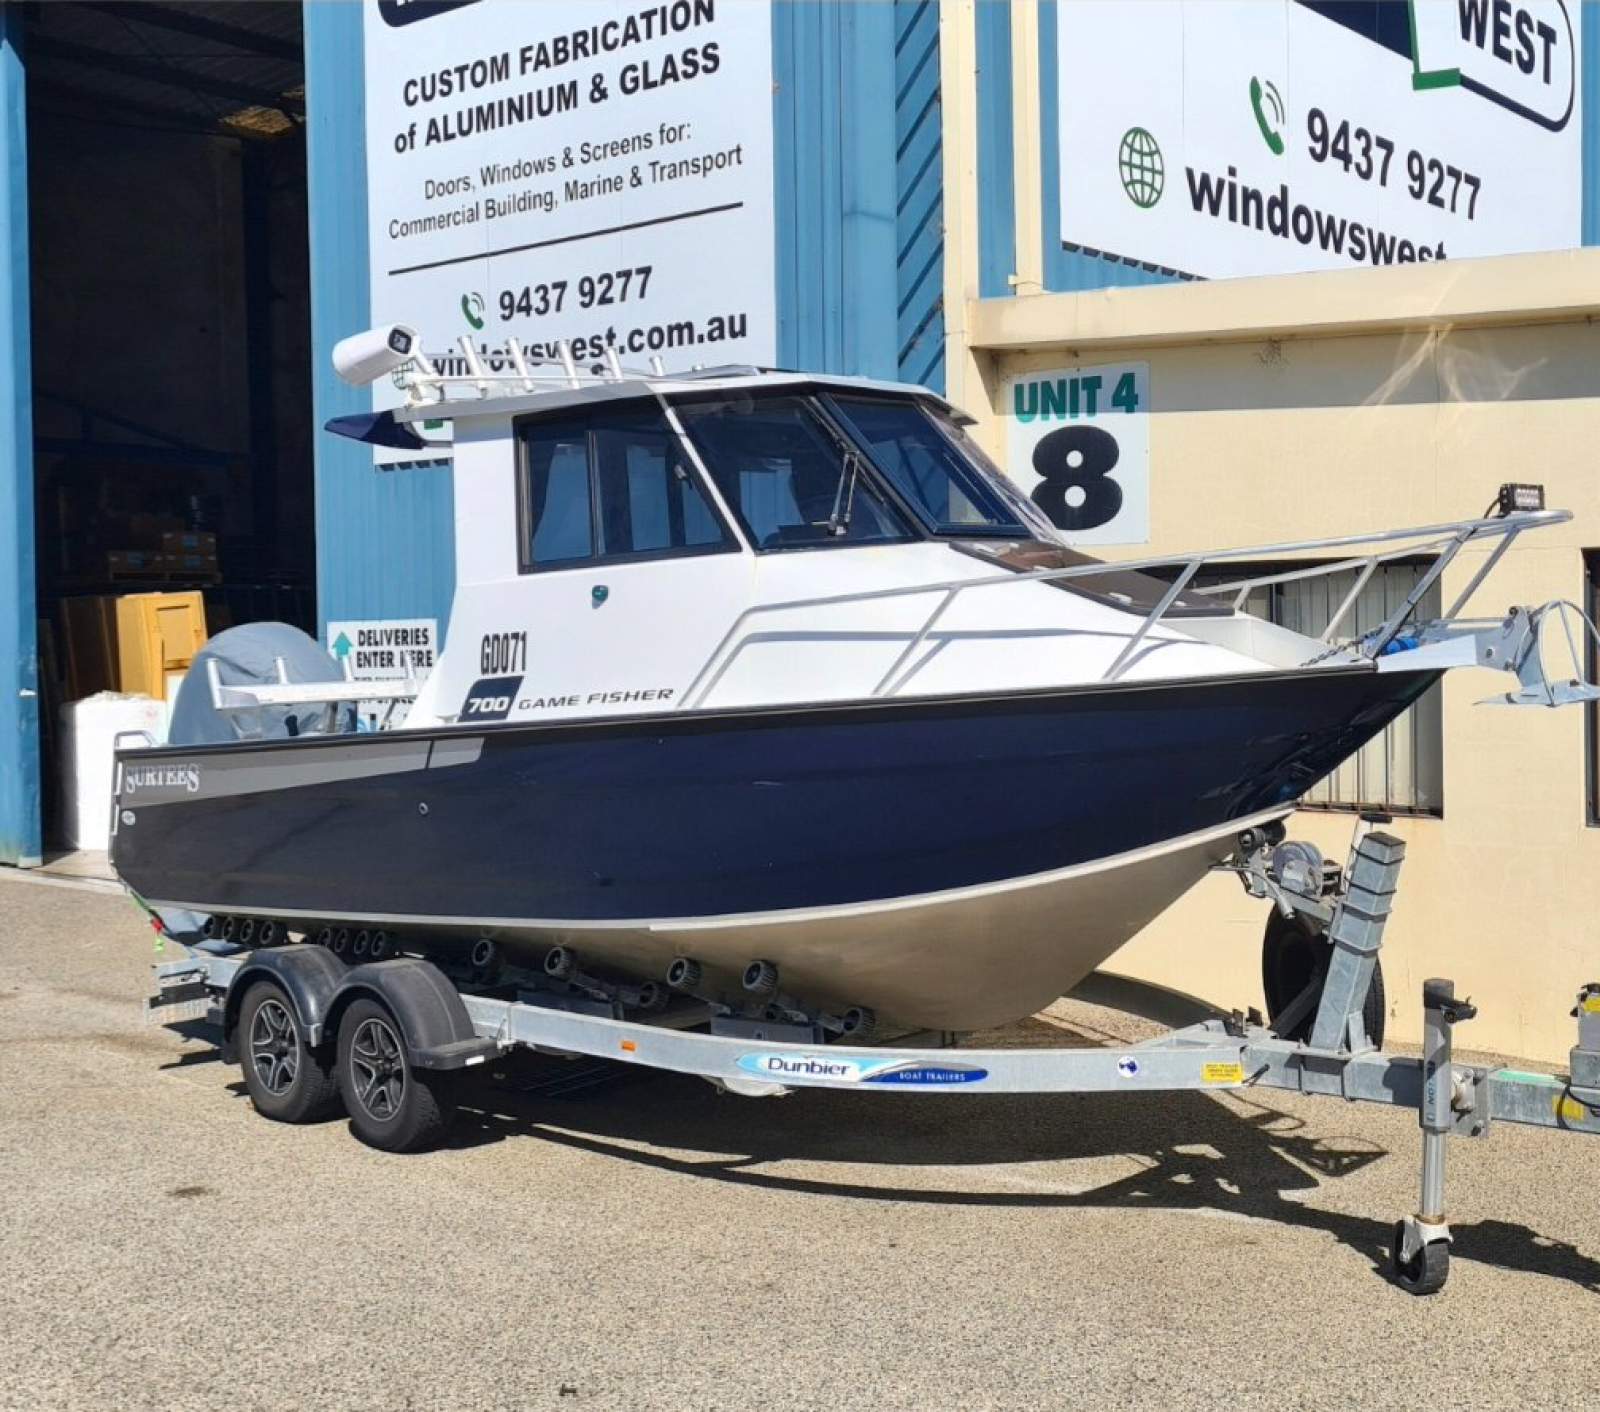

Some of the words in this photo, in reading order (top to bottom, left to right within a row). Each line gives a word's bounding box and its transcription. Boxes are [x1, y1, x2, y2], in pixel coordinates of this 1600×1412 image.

[403, 52, 511, 107] CUSTOM
[519, 0, 715, 76] FABRICATION
[1458, 0, 1557, 85] WEST
[394, 125, 417, 154] of
[424, 80, 579, 147] ALUMINIUM
[589, 73, 608, 103] &
[619, 42, 721, 96] GLASS
[388, 205, 480, 239] Commercial
[485, 188, 558, 220] Building,
[564, 172, 624, 201] Marine
[629, 166, 643, 188] &
[649, 144, 743, 183] Transport
[424, 176, 477, 200] Doors,
[480, 156, 556, 187] Windows
[561, 146, 574, 168] &
[580, 131, 653, 164] Screens
[658, 120, 692, 146] for:
[1307, 107, 1395, 188] 9437
[1407, 149, 1482, 221] 9277
[499, 280, 569, 322] 9437
[578, 265, 653, 309] 9277
[1014, 375, 1102, 423] UNIT
[1111, 372, 1138, 413] 4
[1030, 425, 1122, 530] 8
[356, 651, 394, 668] ENTER
[358, 628, 429, 647] DELIVERIES
[468, 696, 509, 713] 700
[518, 694, 580, 710] GAME
[587, 688, 674, 704] FISHER
[767, 1057, 850, 1076] Dunbier
[899, 1071, 922, 1081] BOAT
